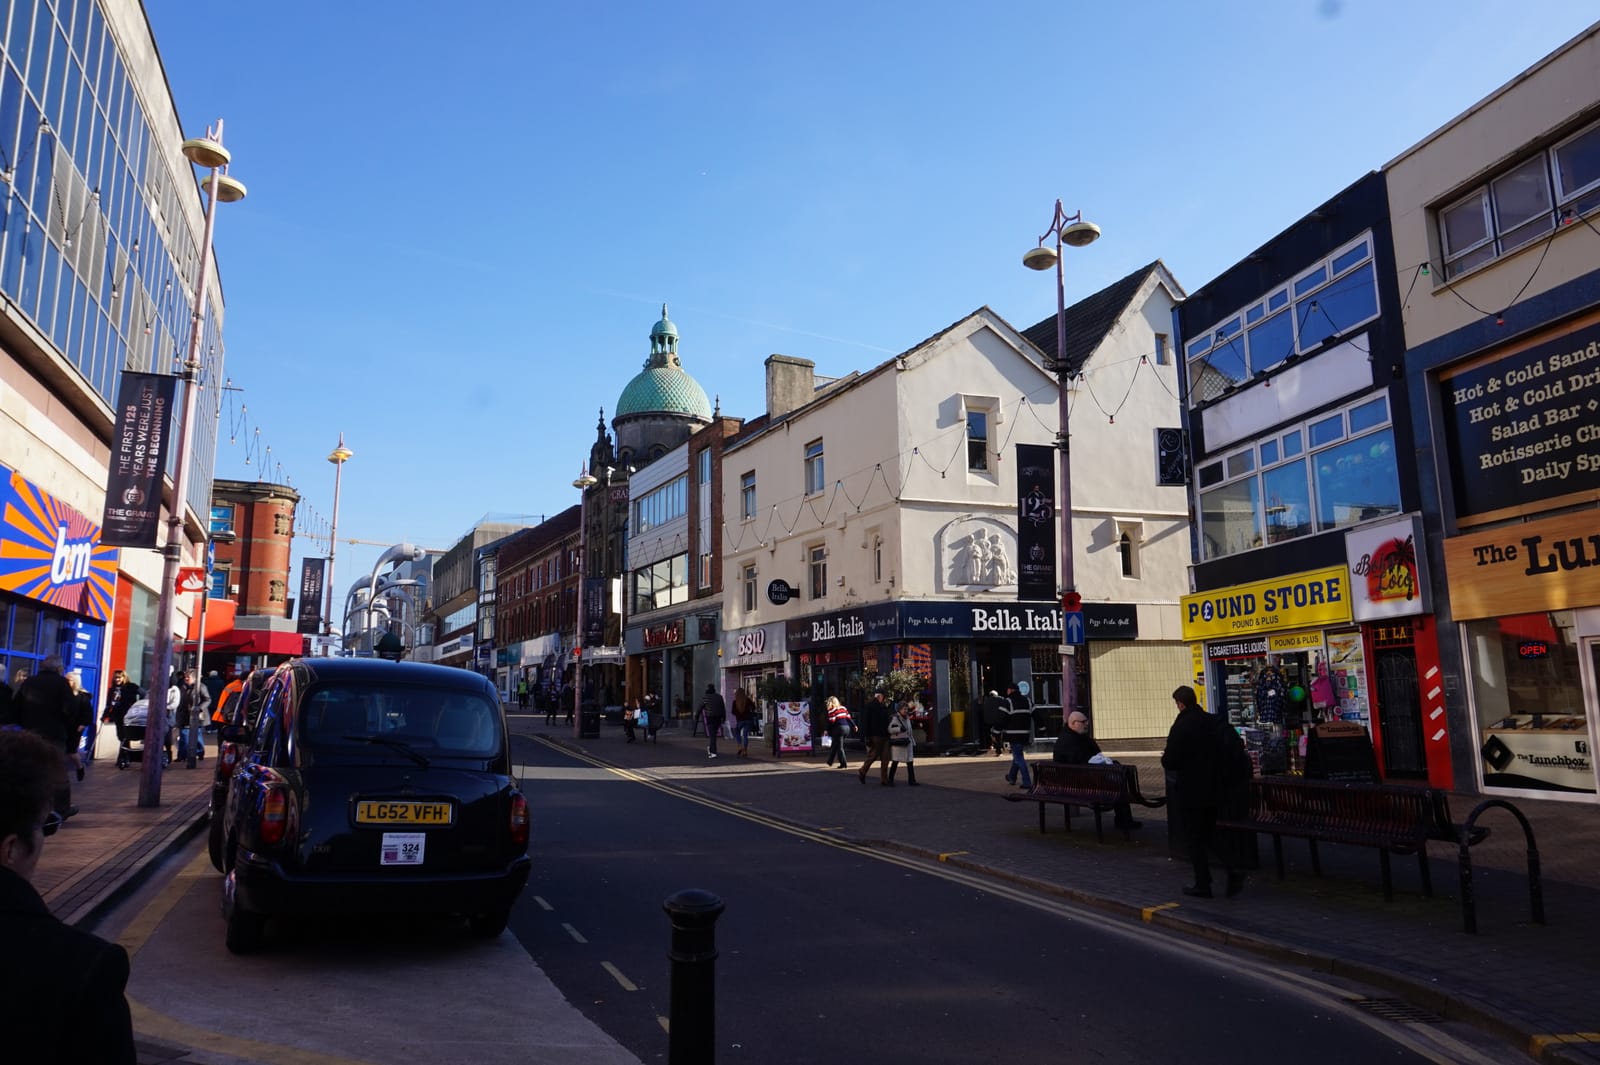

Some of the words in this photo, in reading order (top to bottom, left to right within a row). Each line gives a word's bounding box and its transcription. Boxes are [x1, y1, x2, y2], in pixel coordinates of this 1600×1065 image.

[1453, 383, 1484, 405] Hot
[1486, 377, 1502, 393] &
[1505, 360, 1545, 387] Cold
[1549, 341, 1600, 372] Sand
[141, 386, 153, 411] JUST
[1469, 402, 1501, 424] Hot
[1504, 396, 1520, 412] &
[1523, 380, 1565, 406] Cold
[125, 405, 137, 423] 125
[1491, 415, 1540, 441] Salad
[1543, 404, 1582, 426] Bar
[137, 413, 150, 442] WERE
[149, 397, 165, 455] BEGINNING
[121, 425, 133, 453] FIRST
[133, 444, 146, 477] YEARS
[1479, 433, 1572, 470] Rotisserie
[118, 456, 130, 476] THE
[146, 458, 158, 478] THE
[1521, 461, 1572, 485] Daily
[1020, 497, 1053, 519] 125
[1473, 544, 1518, 567] The
[771, 583, 788, 592] Bella
[1264, 577, 1341, 612] STORE
[811, 621, 836, 642] Bella
[837, 616, 865, 639] Italia
[907, 616, 922, 626] Pizza
[923, 617, 938, 625] Pasta
[940, 616, 954, 626] Grill
[971, 608, 1022, 632] Bella
[1024, 608, 1063, 632] Itali
[1232, 617, 1254, 629] POUND
[1255, 618, 1261, 627] &
[1261, 615, 1279, 625] PLUS
[1209, 646, 1214, 657] E
[1214, 645, 1240, 656] CIGARETTES
[1245, 643, 1249, 653] E
[1249, 641, 1267, 653] LIQUIDS
[1274, 638, 1295, 648] POUND
[1296, 637, 1301, 645] &
[1302, 635, 1319, 645] PLUS
[1519, 644, 1547, 655] OPEN
[1528, 754, 1585, 766] Lunchbox
[367, 804, 409, 819] LG52
[413, 805, 443, 820] VFH
[402, 843, 420, 852] 324
